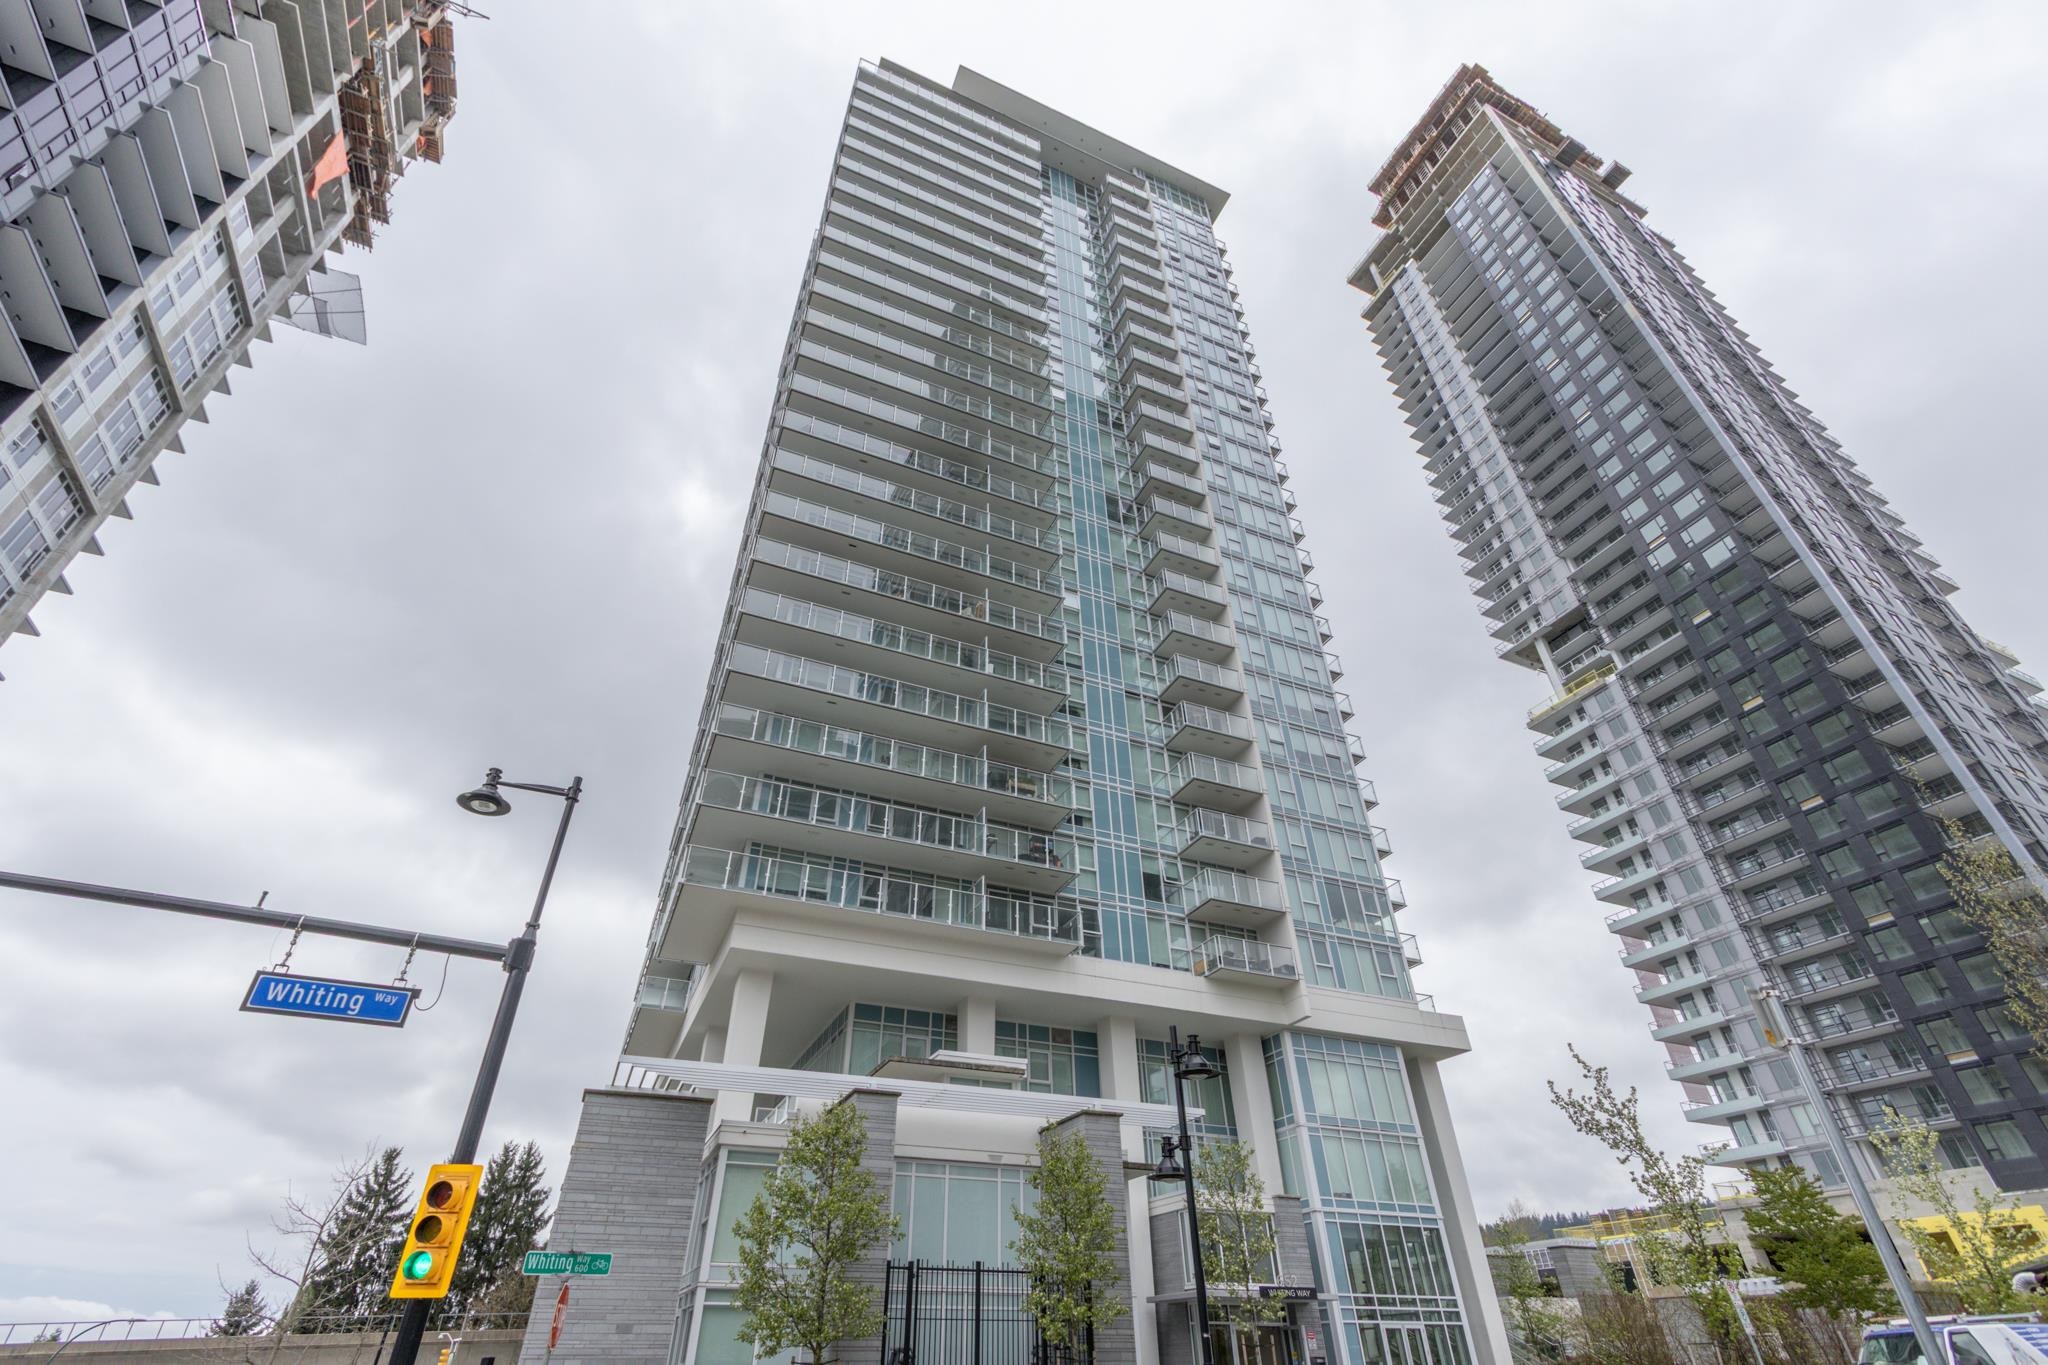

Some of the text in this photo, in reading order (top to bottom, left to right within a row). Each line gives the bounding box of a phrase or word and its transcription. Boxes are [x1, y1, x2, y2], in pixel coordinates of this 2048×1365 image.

[267, 981, 399, 1015] Whiting Way
[527, 1253, 591, 1274] Whiting Way
[575, 1264, 588, 1272] 600
[1296, 1289, 1310, 1297] WAY
